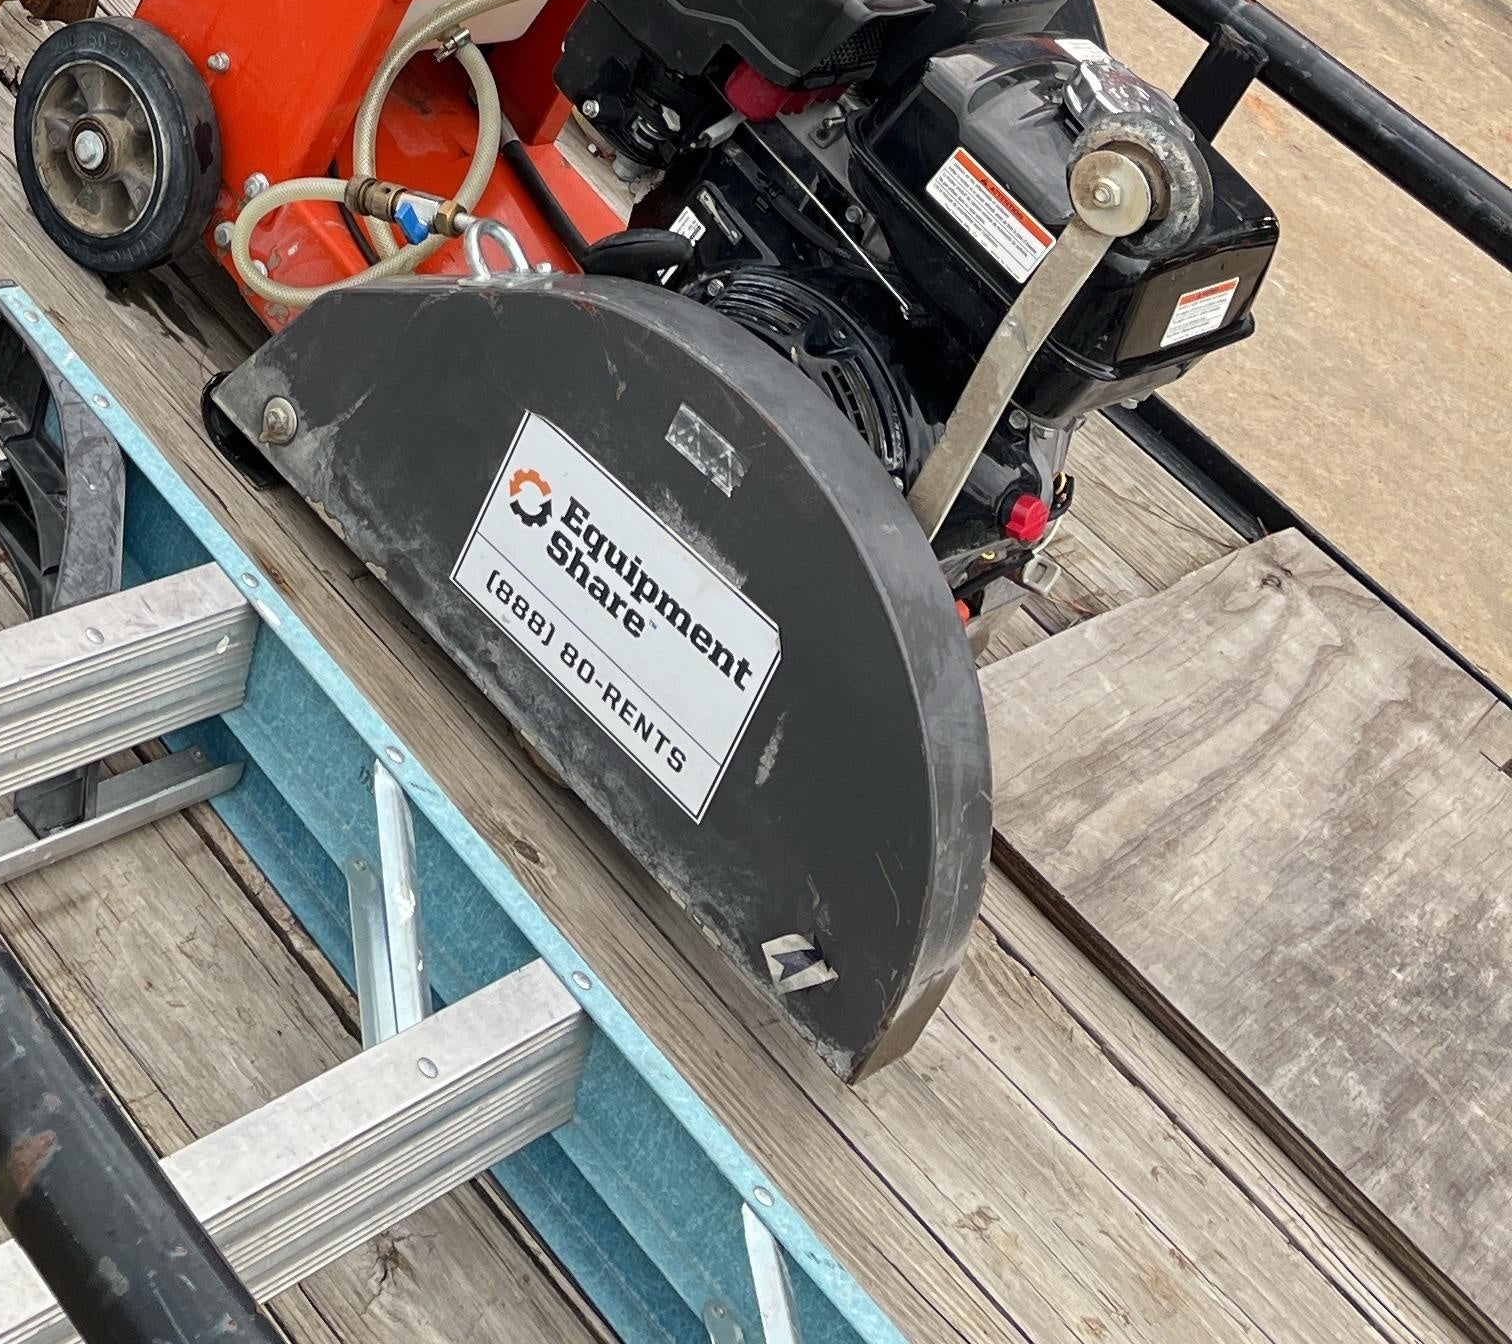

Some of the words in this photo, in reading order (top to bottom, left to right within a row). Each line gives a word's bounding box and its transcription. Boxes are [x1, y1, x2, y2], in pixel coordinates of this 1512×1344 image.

[486, 569, 556, 647] (888)
[561, 643, 687, 774] 80-RENTS
[545, 529, 646, 639] Share
[561, 496, 753, 692] Equipment
